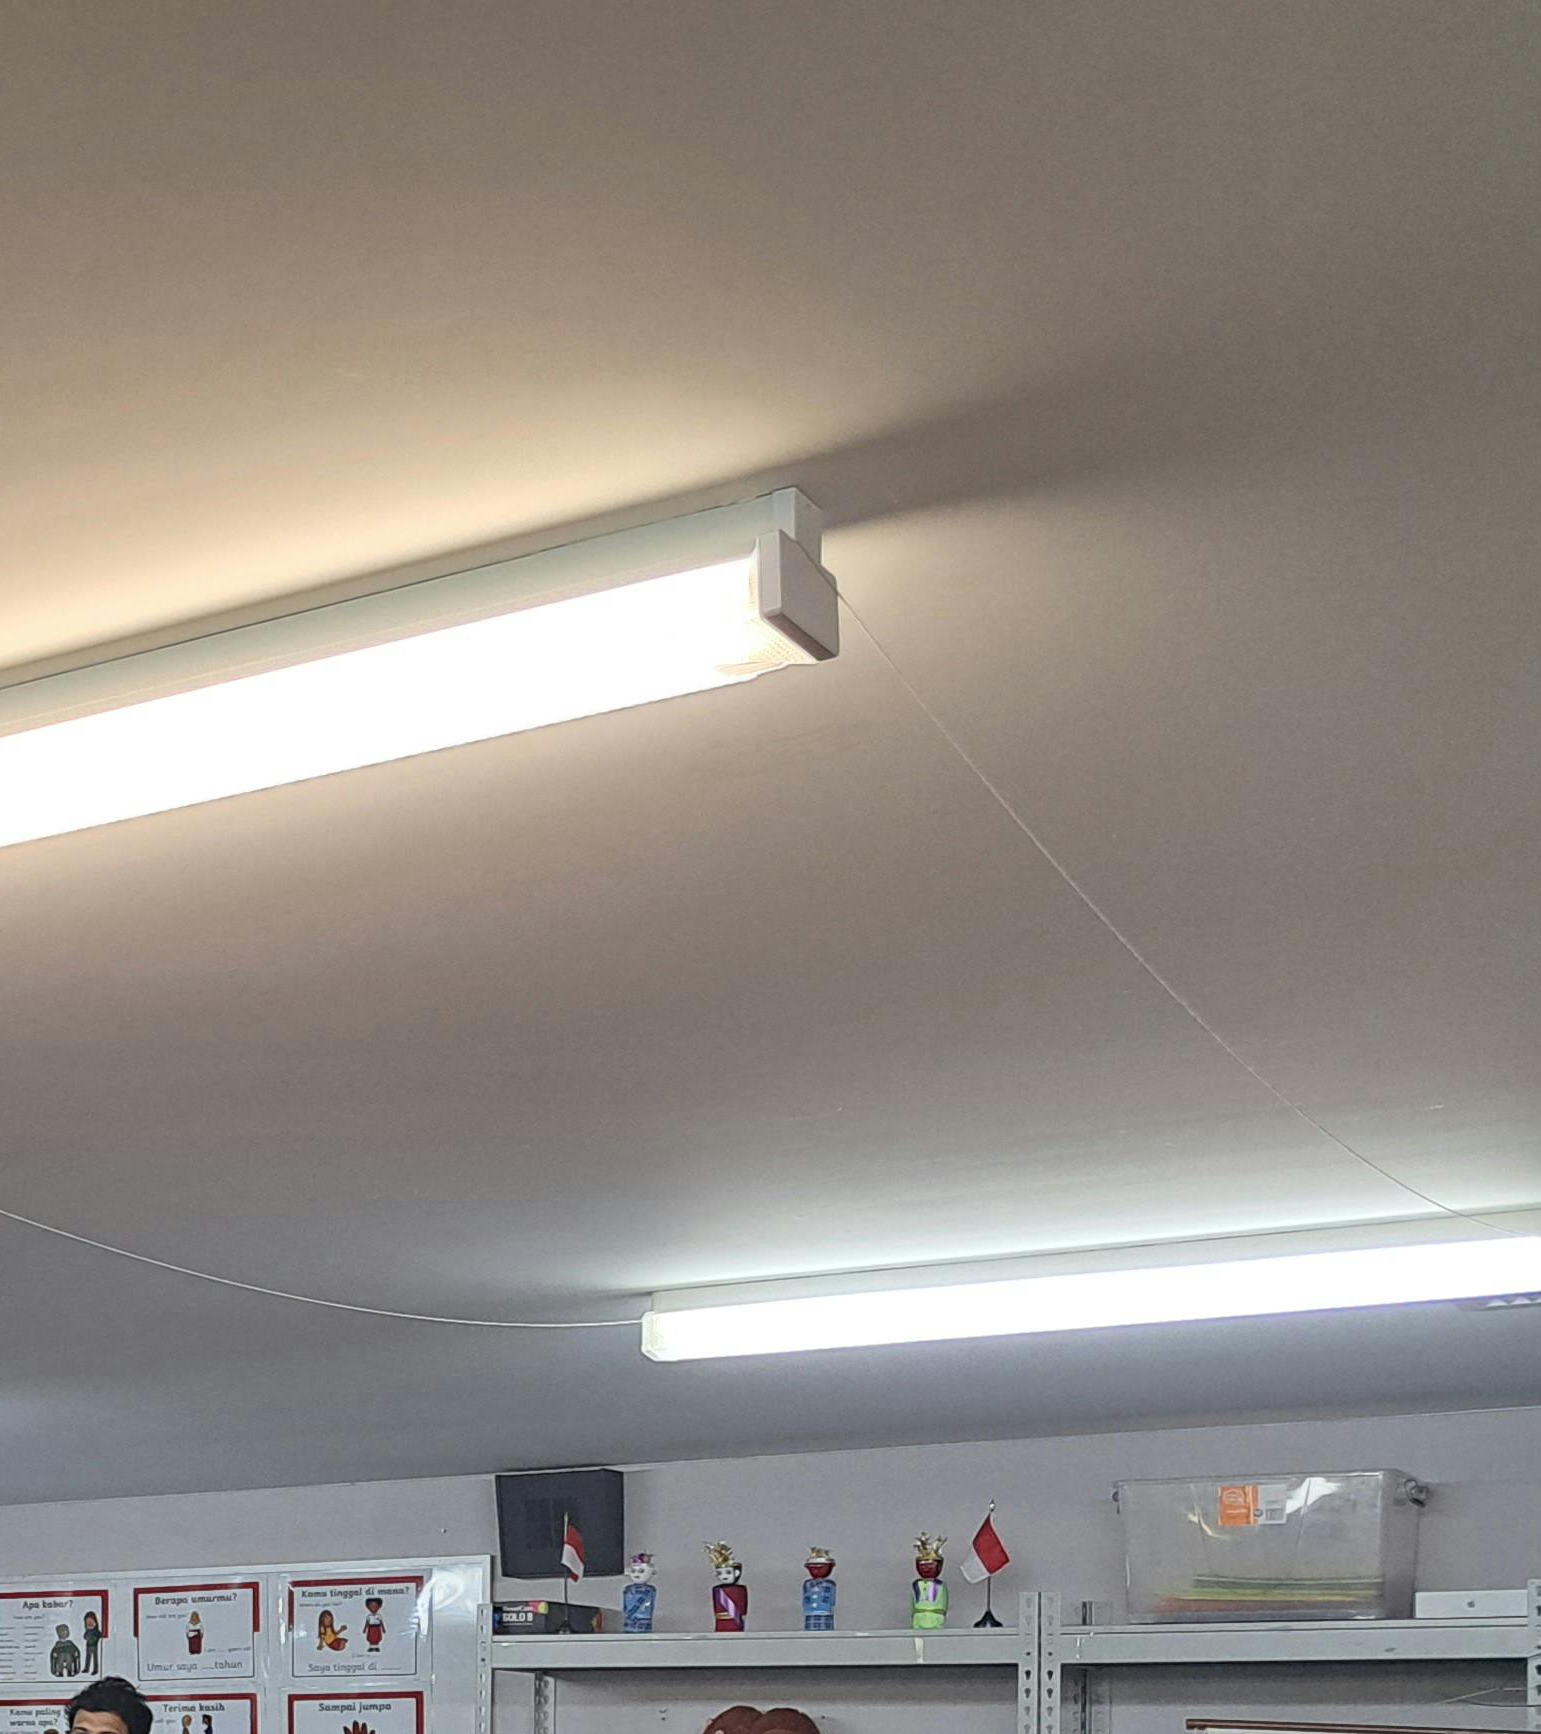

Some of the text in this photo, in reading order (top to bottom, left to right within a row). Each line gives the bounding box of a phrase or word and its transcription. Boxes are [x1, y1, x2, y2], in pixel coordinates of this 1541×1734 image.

[155, 1592, 238, 1606] Berapa umurmu?
[330, 1588, 363, 1599] tinggal
[365, 1587, 374, 1595] di
[22, 1599, 74, 1611] Apa kabar?
[147, 1663, 173, 1672] Umur
[177, 1663, 197, 1672] saya
[308, 1662, 377, 1673] Saya tinggal di
[163, 1703, 225, 1712] Terima kasih
[318, 1701, 392, 1713] Sampai jumpa
